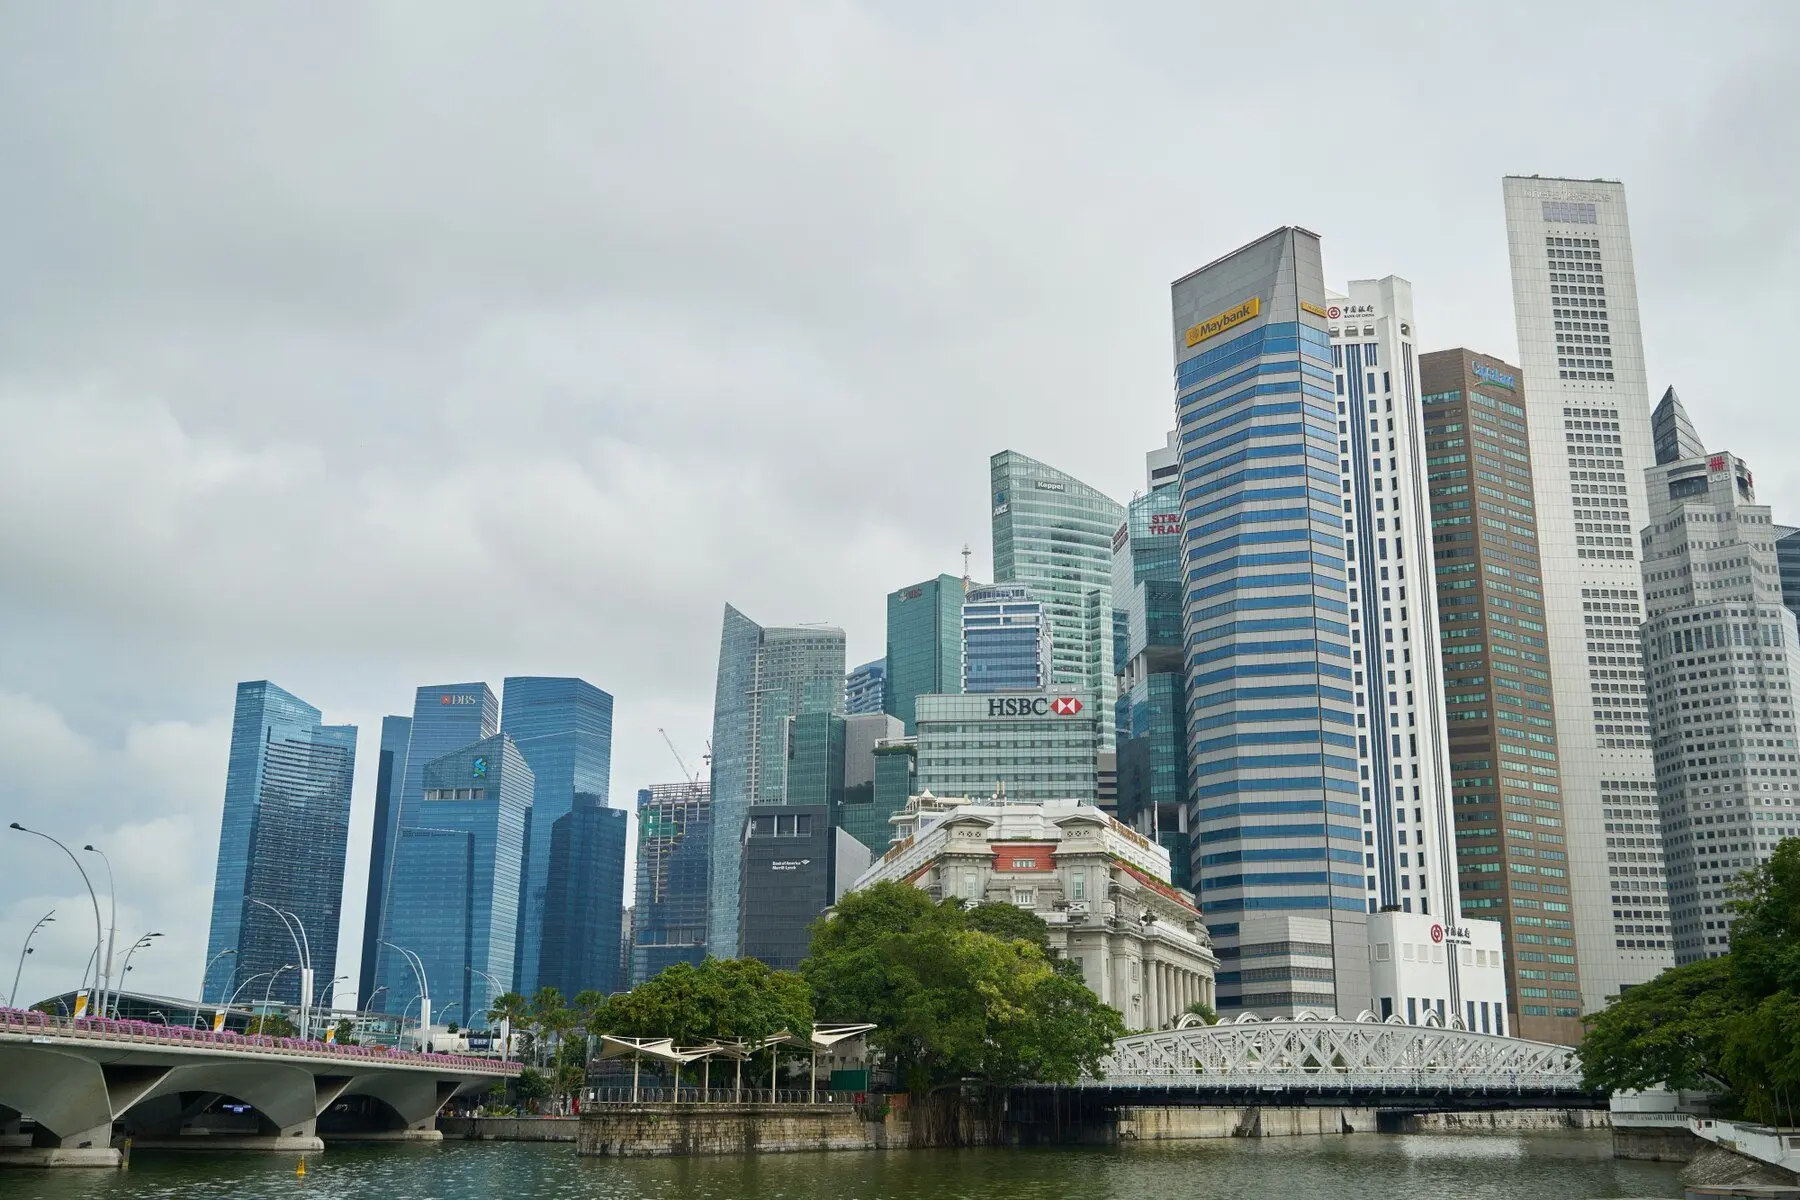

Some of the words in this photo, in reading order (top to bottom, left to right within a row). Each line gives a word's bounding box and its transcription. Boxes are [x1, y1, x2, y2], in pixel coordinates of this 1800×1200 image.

[1200, 305, 1250, 337] Maybank
[1708, 471, 1730, 483] UOB
[1037, 481, 1064, 490] Keppel
[452, 695, 477, 705] DBS
[988, 698, 1048, 716] HSBC
